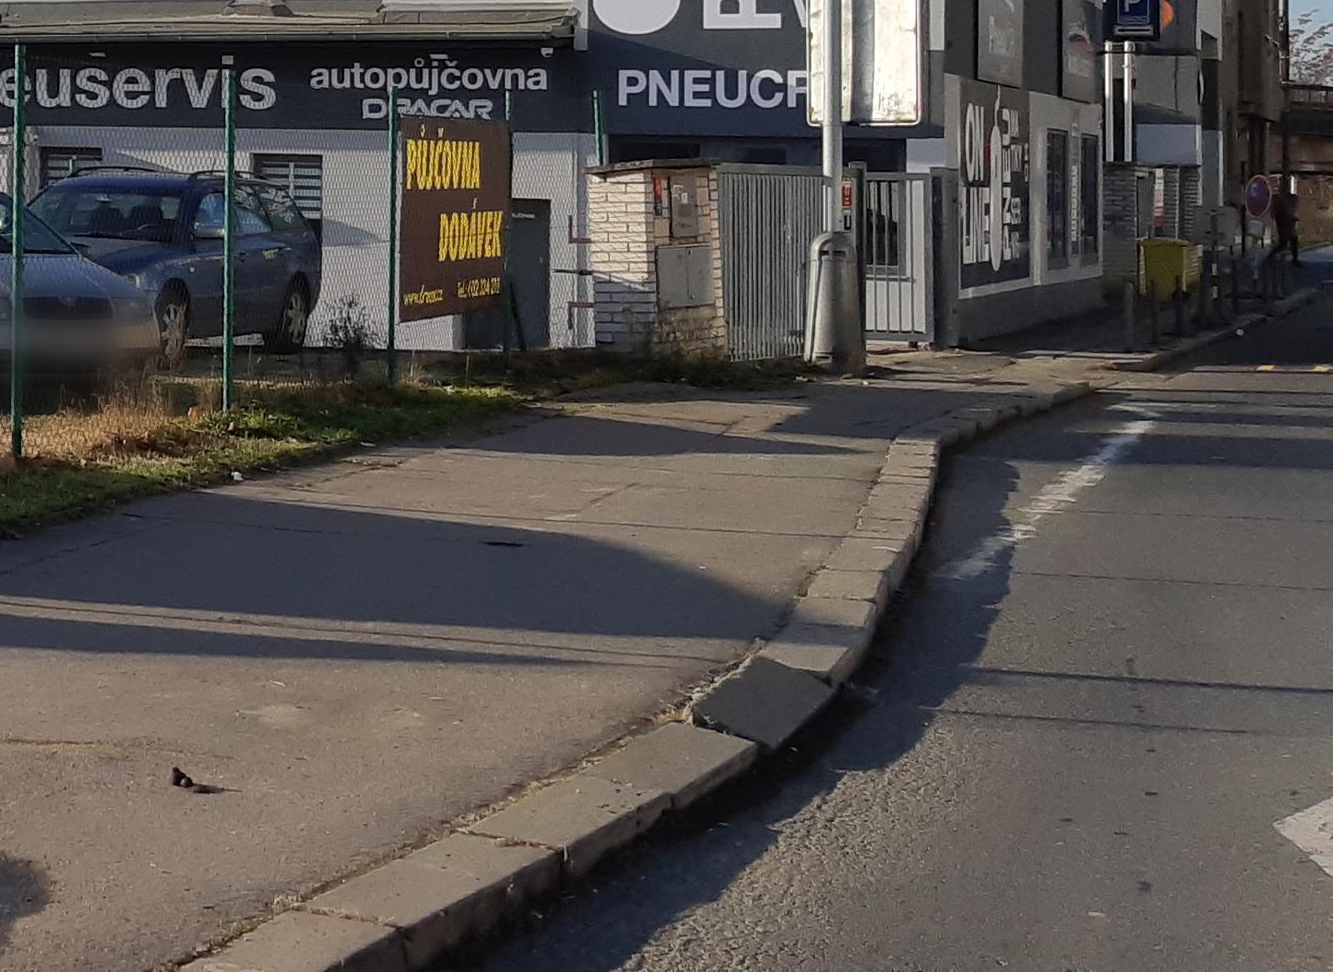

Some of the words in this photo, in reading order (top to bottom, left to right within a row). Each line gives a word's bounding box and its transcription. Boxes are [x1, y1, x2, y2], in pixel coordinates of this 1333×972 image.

[309, 58, 548, 95] autopůjčovna
[406, 124, 481, 190] PŮJČOVNA
[965, 102, 985, 182] ON
[438, 197, 504, 262] DODÁVEK
